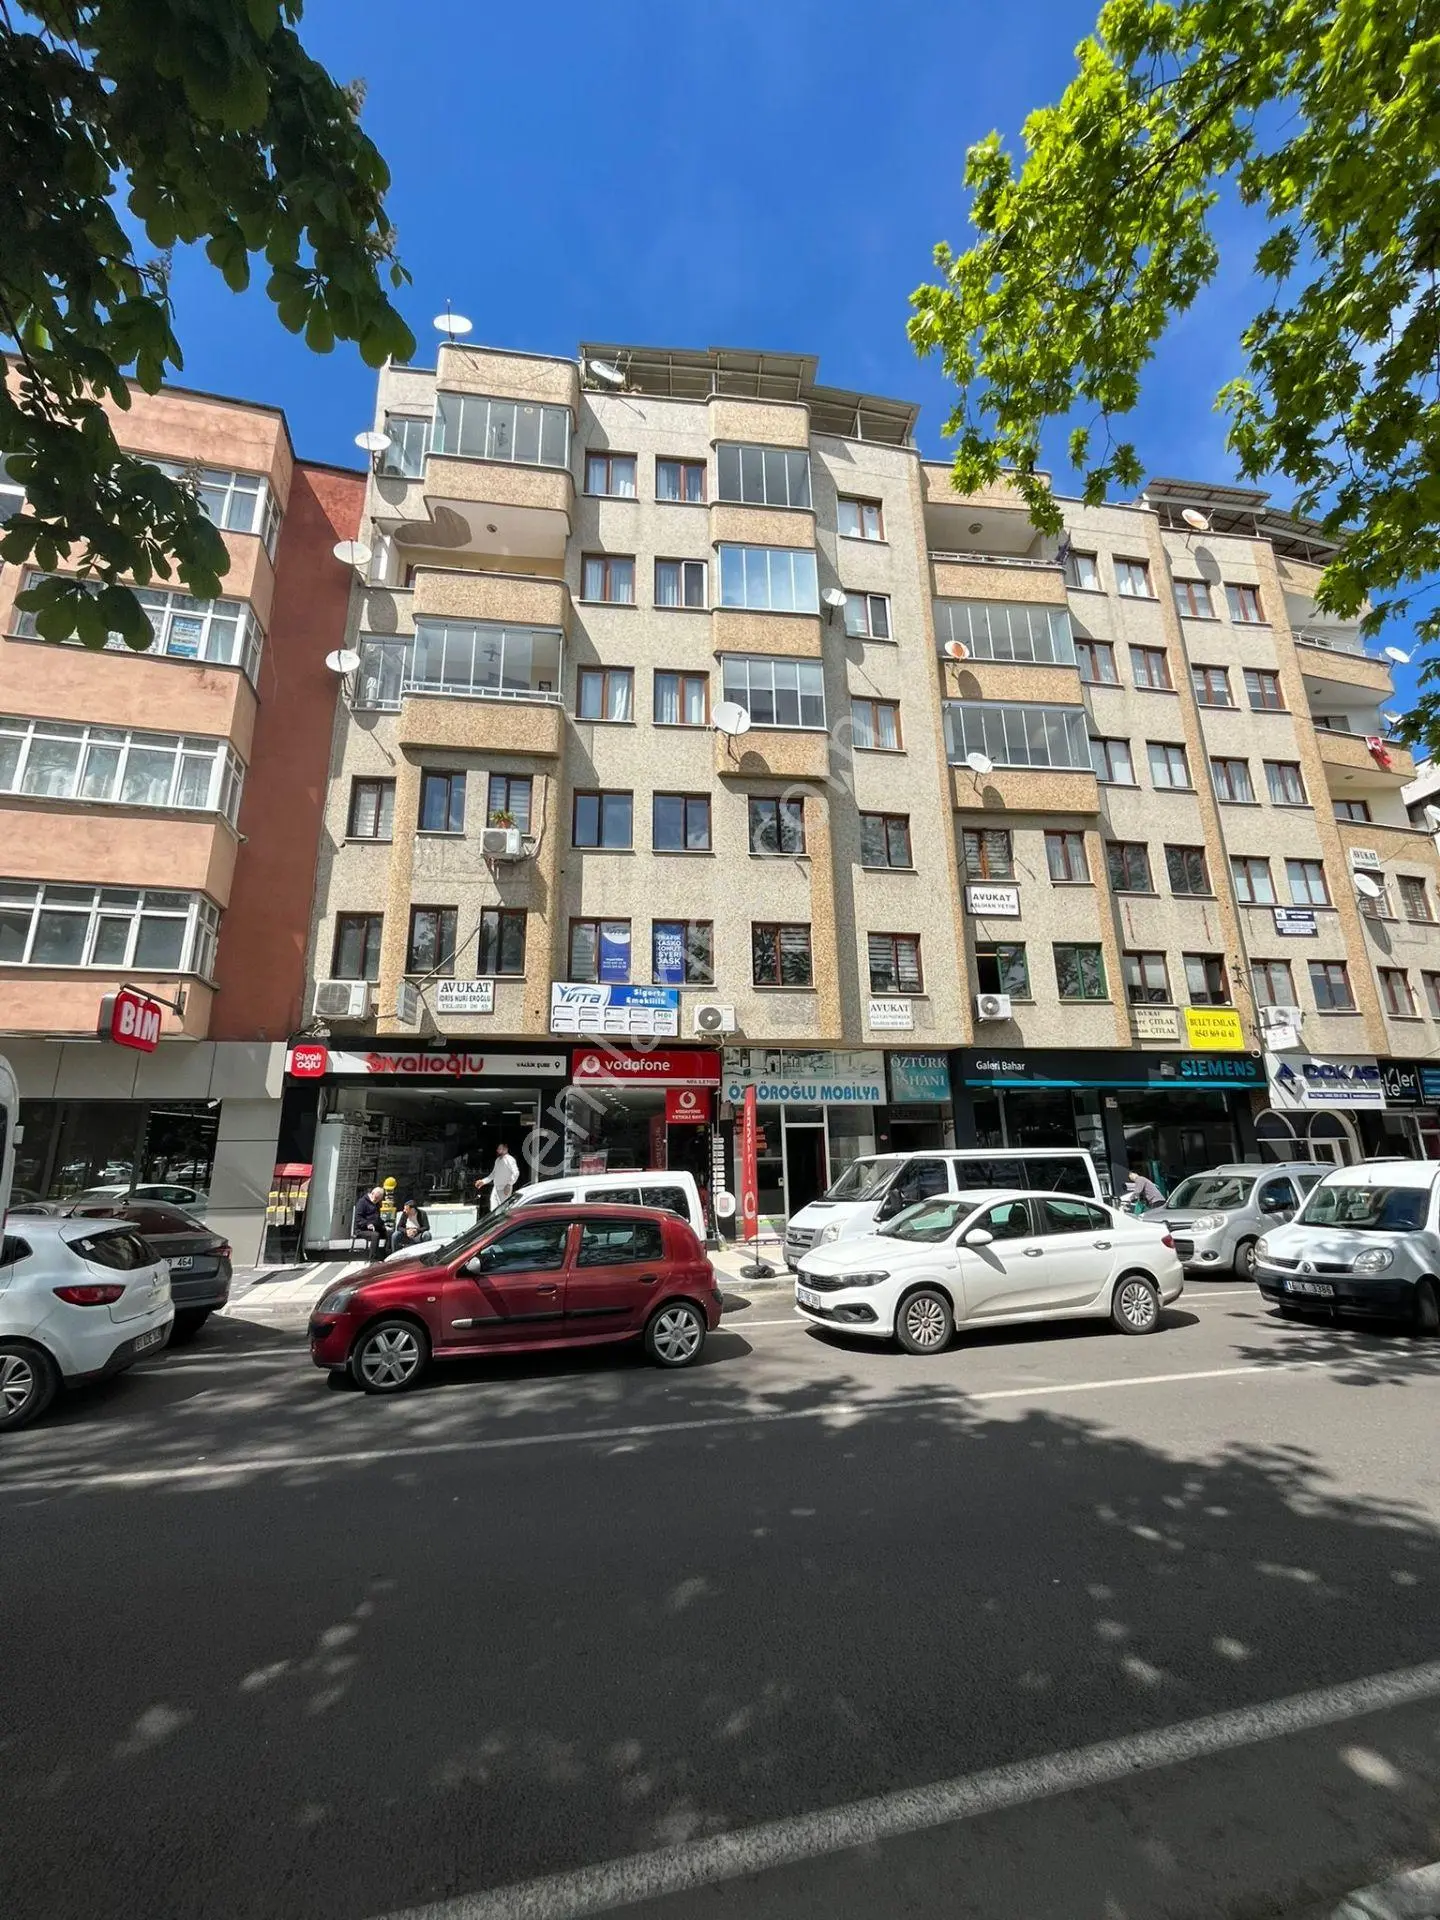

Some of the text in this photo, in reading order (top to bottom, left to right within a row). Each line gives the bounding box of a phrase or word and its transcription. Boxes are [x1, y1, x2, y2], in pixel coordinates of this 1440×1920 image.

[973, 893, 1011, 902] AVUKAT
[440, 982, 491, 993] AVUKAT
[870, 1004, 909, 1012] AVUKAT
[120, 1000, 158, 1043] BİM
[605, 1058, 670, 1071] vodafone
[890, 1054, 947, 1069] ÖZTÜRK
[976, 1060, 1025, 1071] Galeri Bahar
[1180, 1060, 1257, 1077] SIEMENS
[728, 1081, 880, 1100] ÖZÖROĞLU MOBİLYA
[177, 1257, 192, 1267] 464
